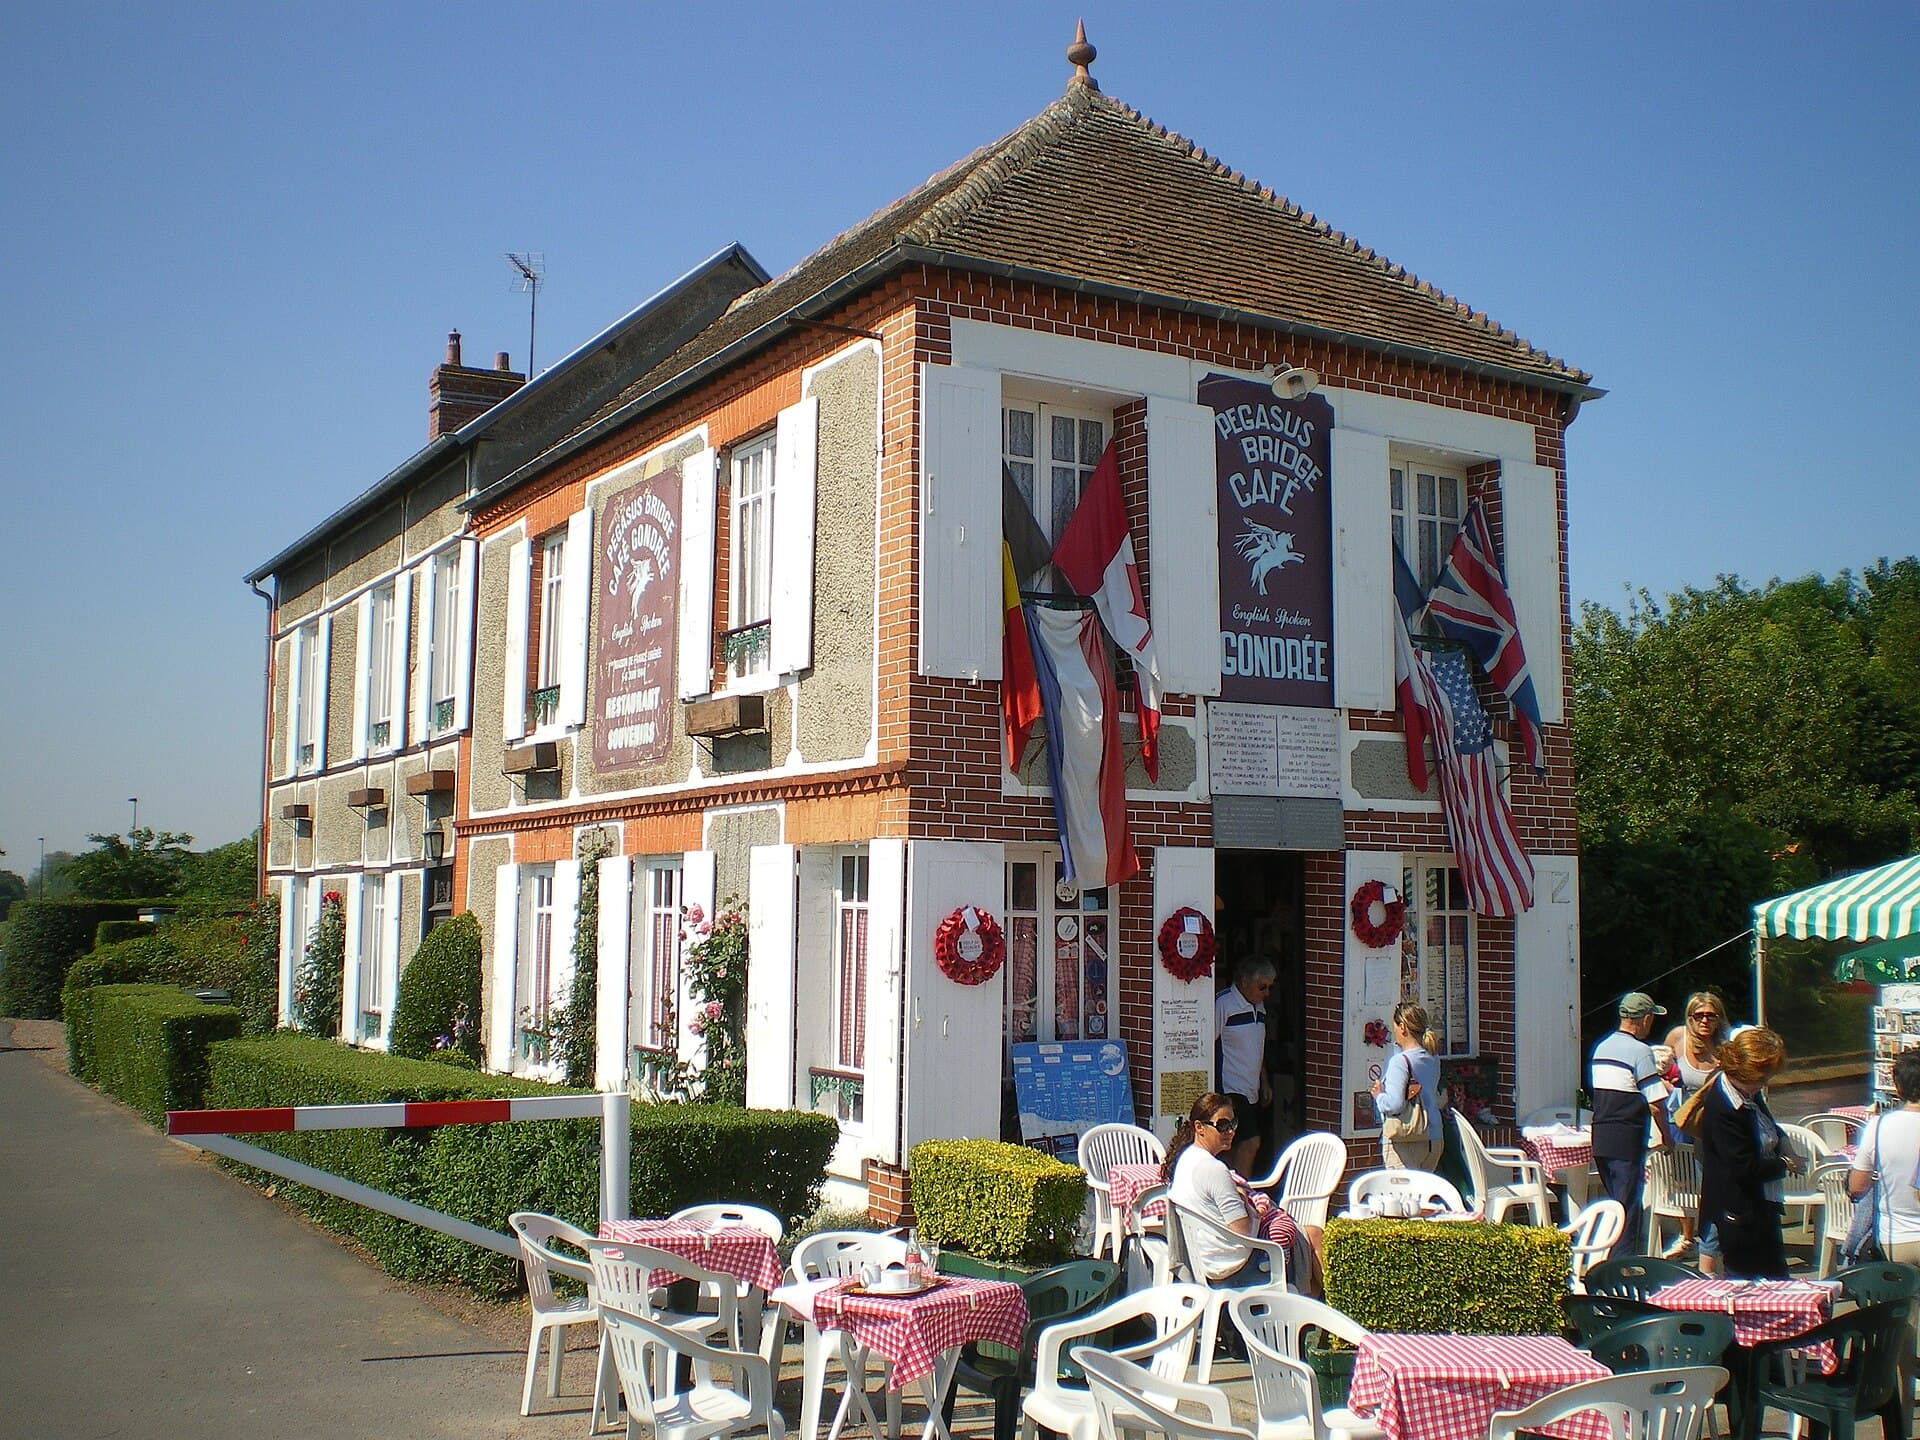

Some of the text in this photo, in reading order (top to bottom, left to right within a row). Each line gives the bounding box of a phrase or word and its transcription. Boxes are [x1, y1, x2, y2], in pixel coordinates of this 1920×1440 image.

[1215, 404, 1315, 448] PEGASUS
[1240, 435, 1322, 492] BRIDGE
[1229, 468, 1301, 516] CAFÉ
[606, 494, 675, 562] PEGASUS BRIDGE
[631, 523, 670, 581] GONDRÉE
[611, 619, 633, 645] English
[1232, 603, 1312, 630] English Spoken
[1220, 631, 1329, 683] GONDRÉE
[605, 686, 661, 720] RESTAURANT
[607, 721, 655, 751] SOUVENIRS
